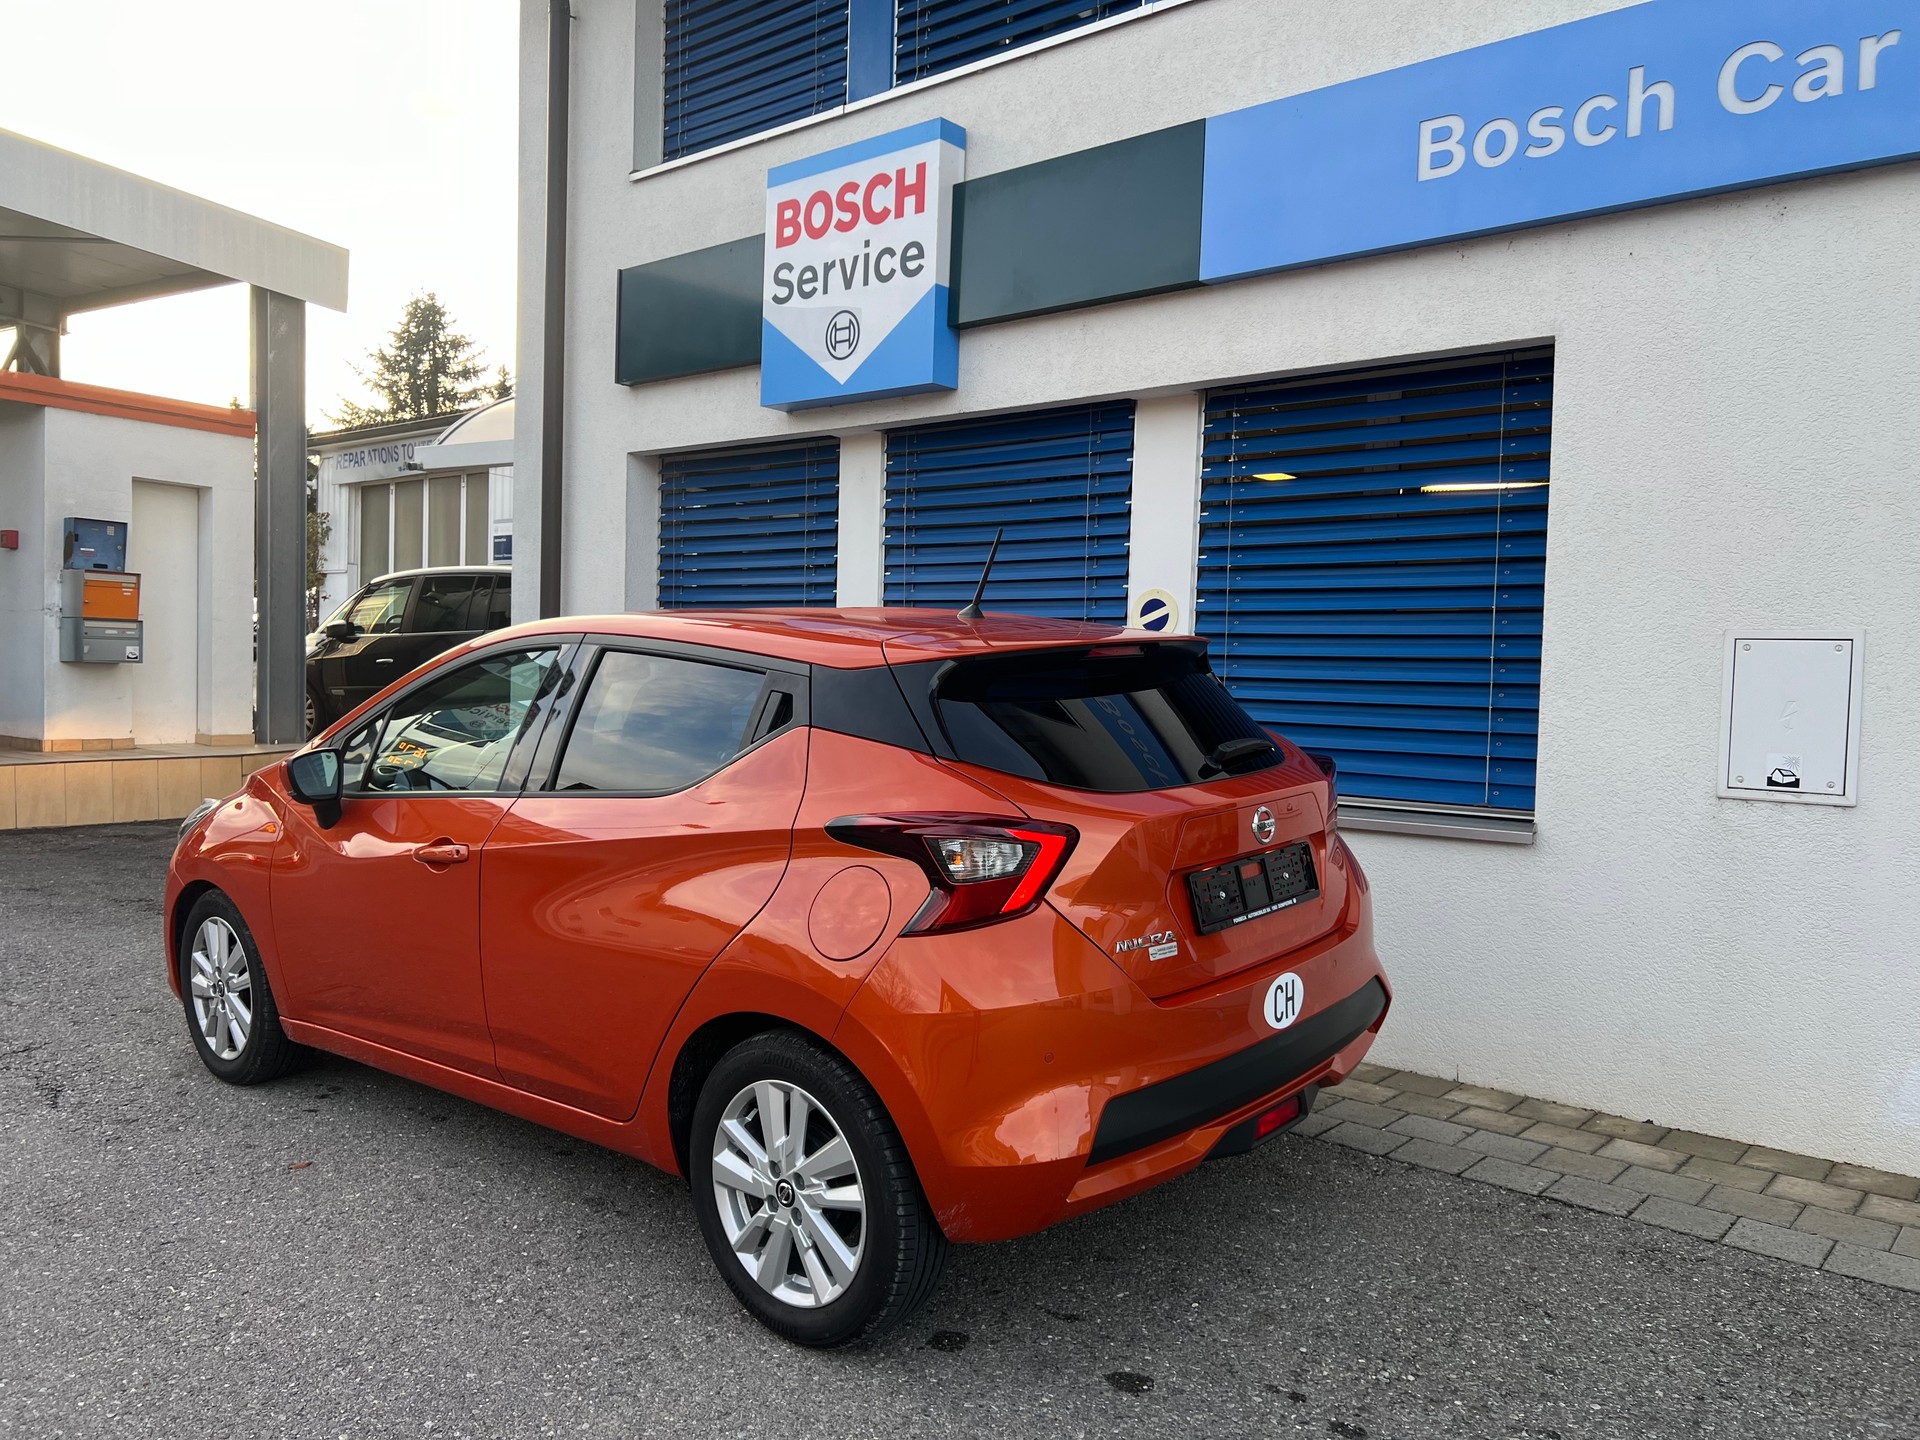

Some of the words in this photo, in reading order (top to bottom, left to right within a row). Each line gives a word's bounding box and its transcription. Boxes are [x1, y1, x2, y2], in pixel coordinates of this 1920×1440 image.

[1417, 65, 1675, 182] Bosch
[1716, 28, 1902, 115] Car
[776, 161, 927, 249] BOSCH
[771, 239, 925, 305] Service
[336, 445, 400, 470] REPARATIONS
[1115, 930, 1177, 954] MICRA
[1274, 979, 1296, 1023] CH
